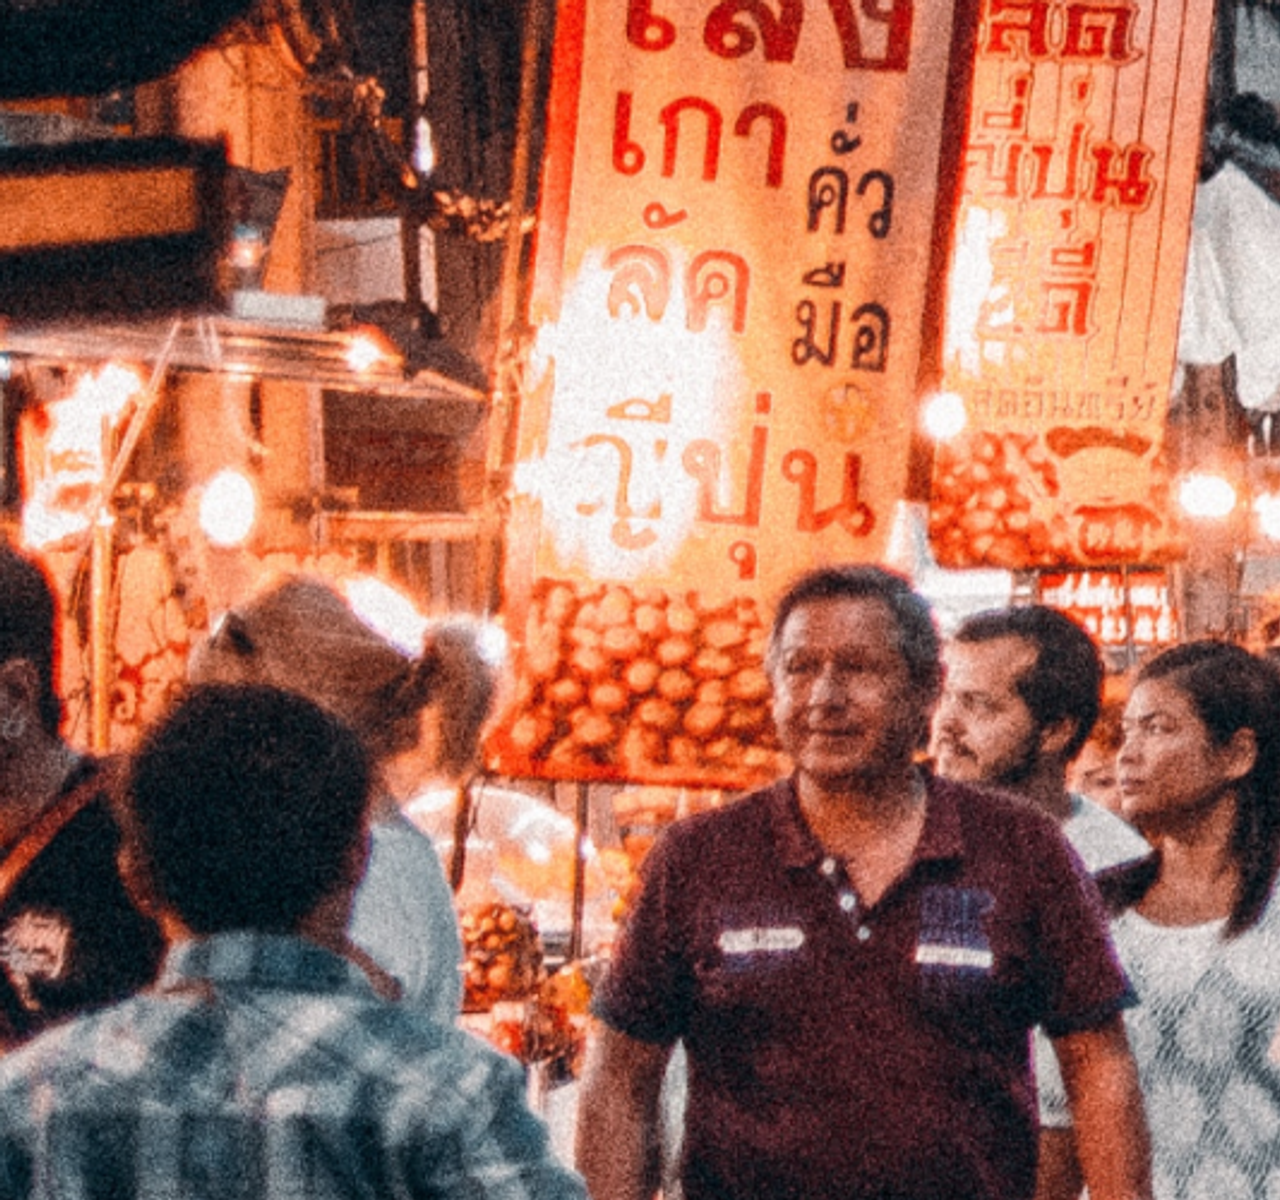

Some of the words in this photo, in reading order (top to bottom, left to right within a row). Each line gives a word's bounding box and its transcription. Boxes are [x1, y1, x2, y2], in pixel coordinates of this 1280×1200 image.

[612, 90, 787, 189] เกา
[806, 101, 895, 240] คั่ว
[791, 262, 892, 374] มือ
